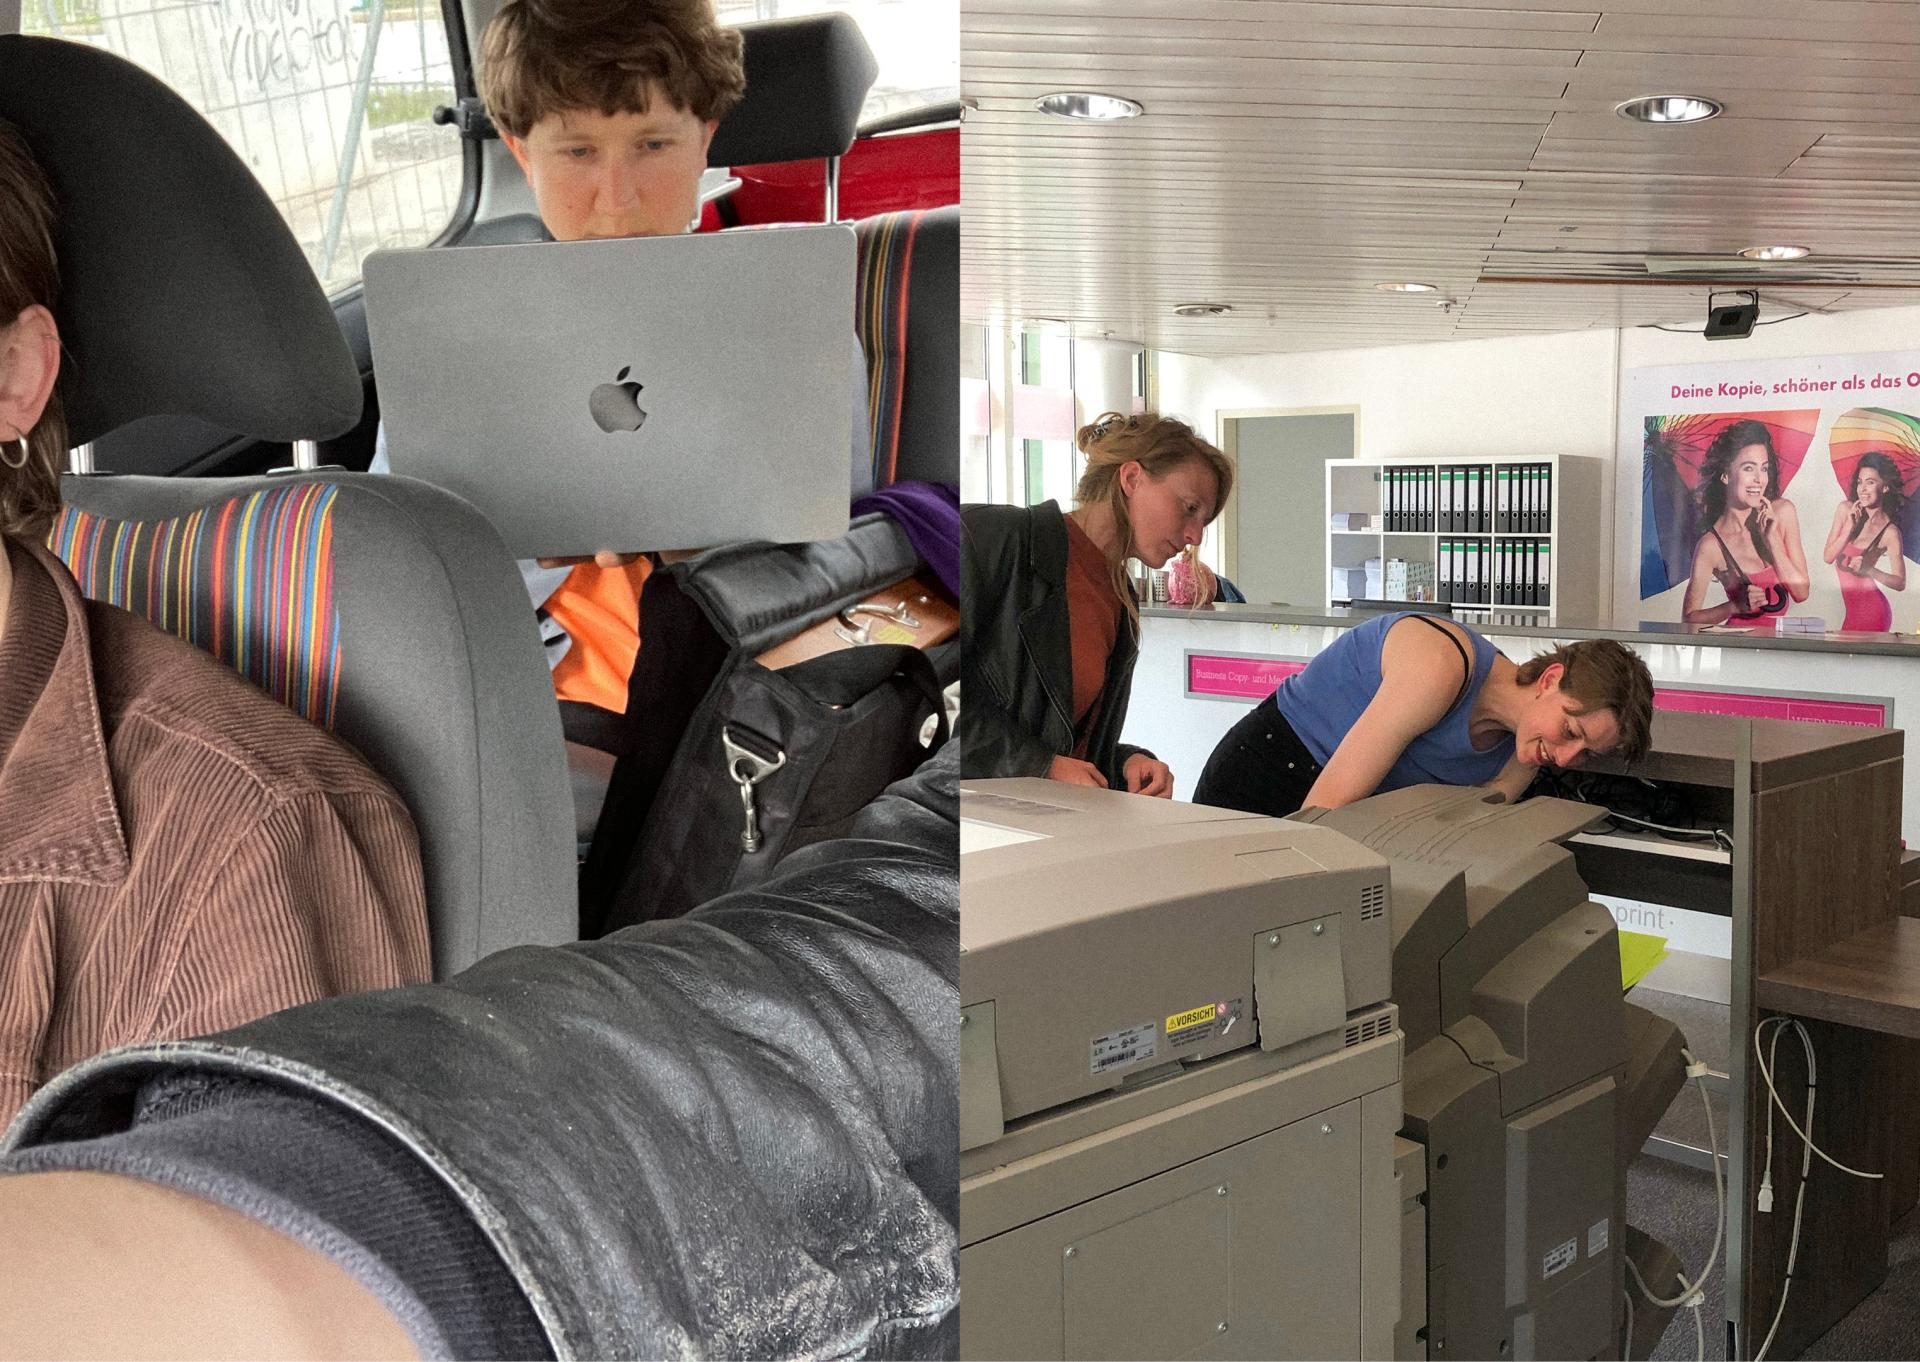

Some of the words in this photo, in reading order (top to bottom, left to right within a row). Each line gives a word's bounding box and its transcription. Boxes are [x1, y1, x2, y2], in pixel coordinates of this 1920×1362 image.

[1671, 384, 1714, 399] Deine
[1718, 380, 1768, 400] Kopie,
[1772, 377, 1837, 394] schöner
[1841, 374, 1866, 390] als
[1870, 372, 1902, 389] das
[1906, 371, 1920, 387] O
[1195, 668, 1227, 681] Business
[1252, 674, 1267, 684] und
[1615, 903, 1665, 930] print
[1176, 1006, 1215, 1026] VORSICHT
